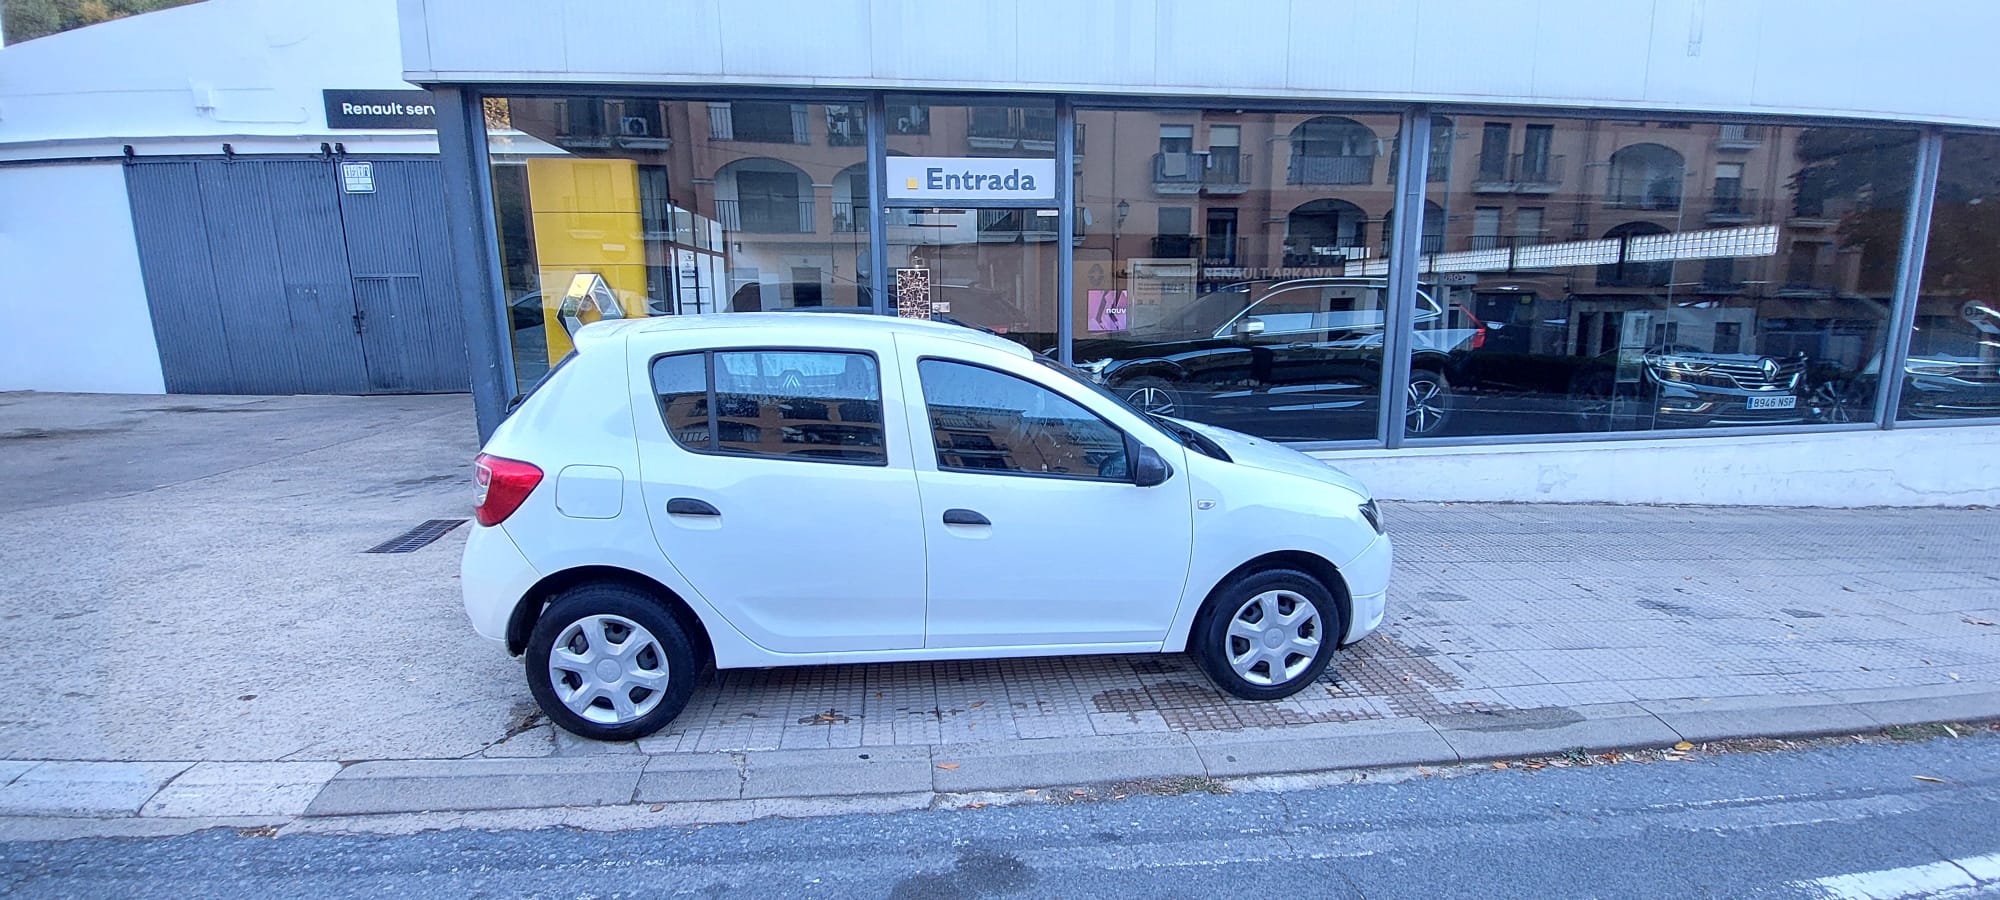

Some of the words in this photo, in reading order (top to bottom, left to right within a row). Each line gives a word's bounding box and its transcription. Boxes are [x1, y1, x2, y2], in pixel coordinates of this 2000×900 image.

[342, 102, 403, 115] Renault
[926, 167, 1036, 190] Entrada
[1203, 267, 1268, 280] RENAULT
[1272, 267, 1333, 279] ARKANA
[1754, 398, 1776, 407] 8946
[1778, 397, 1795, 407] NSP
